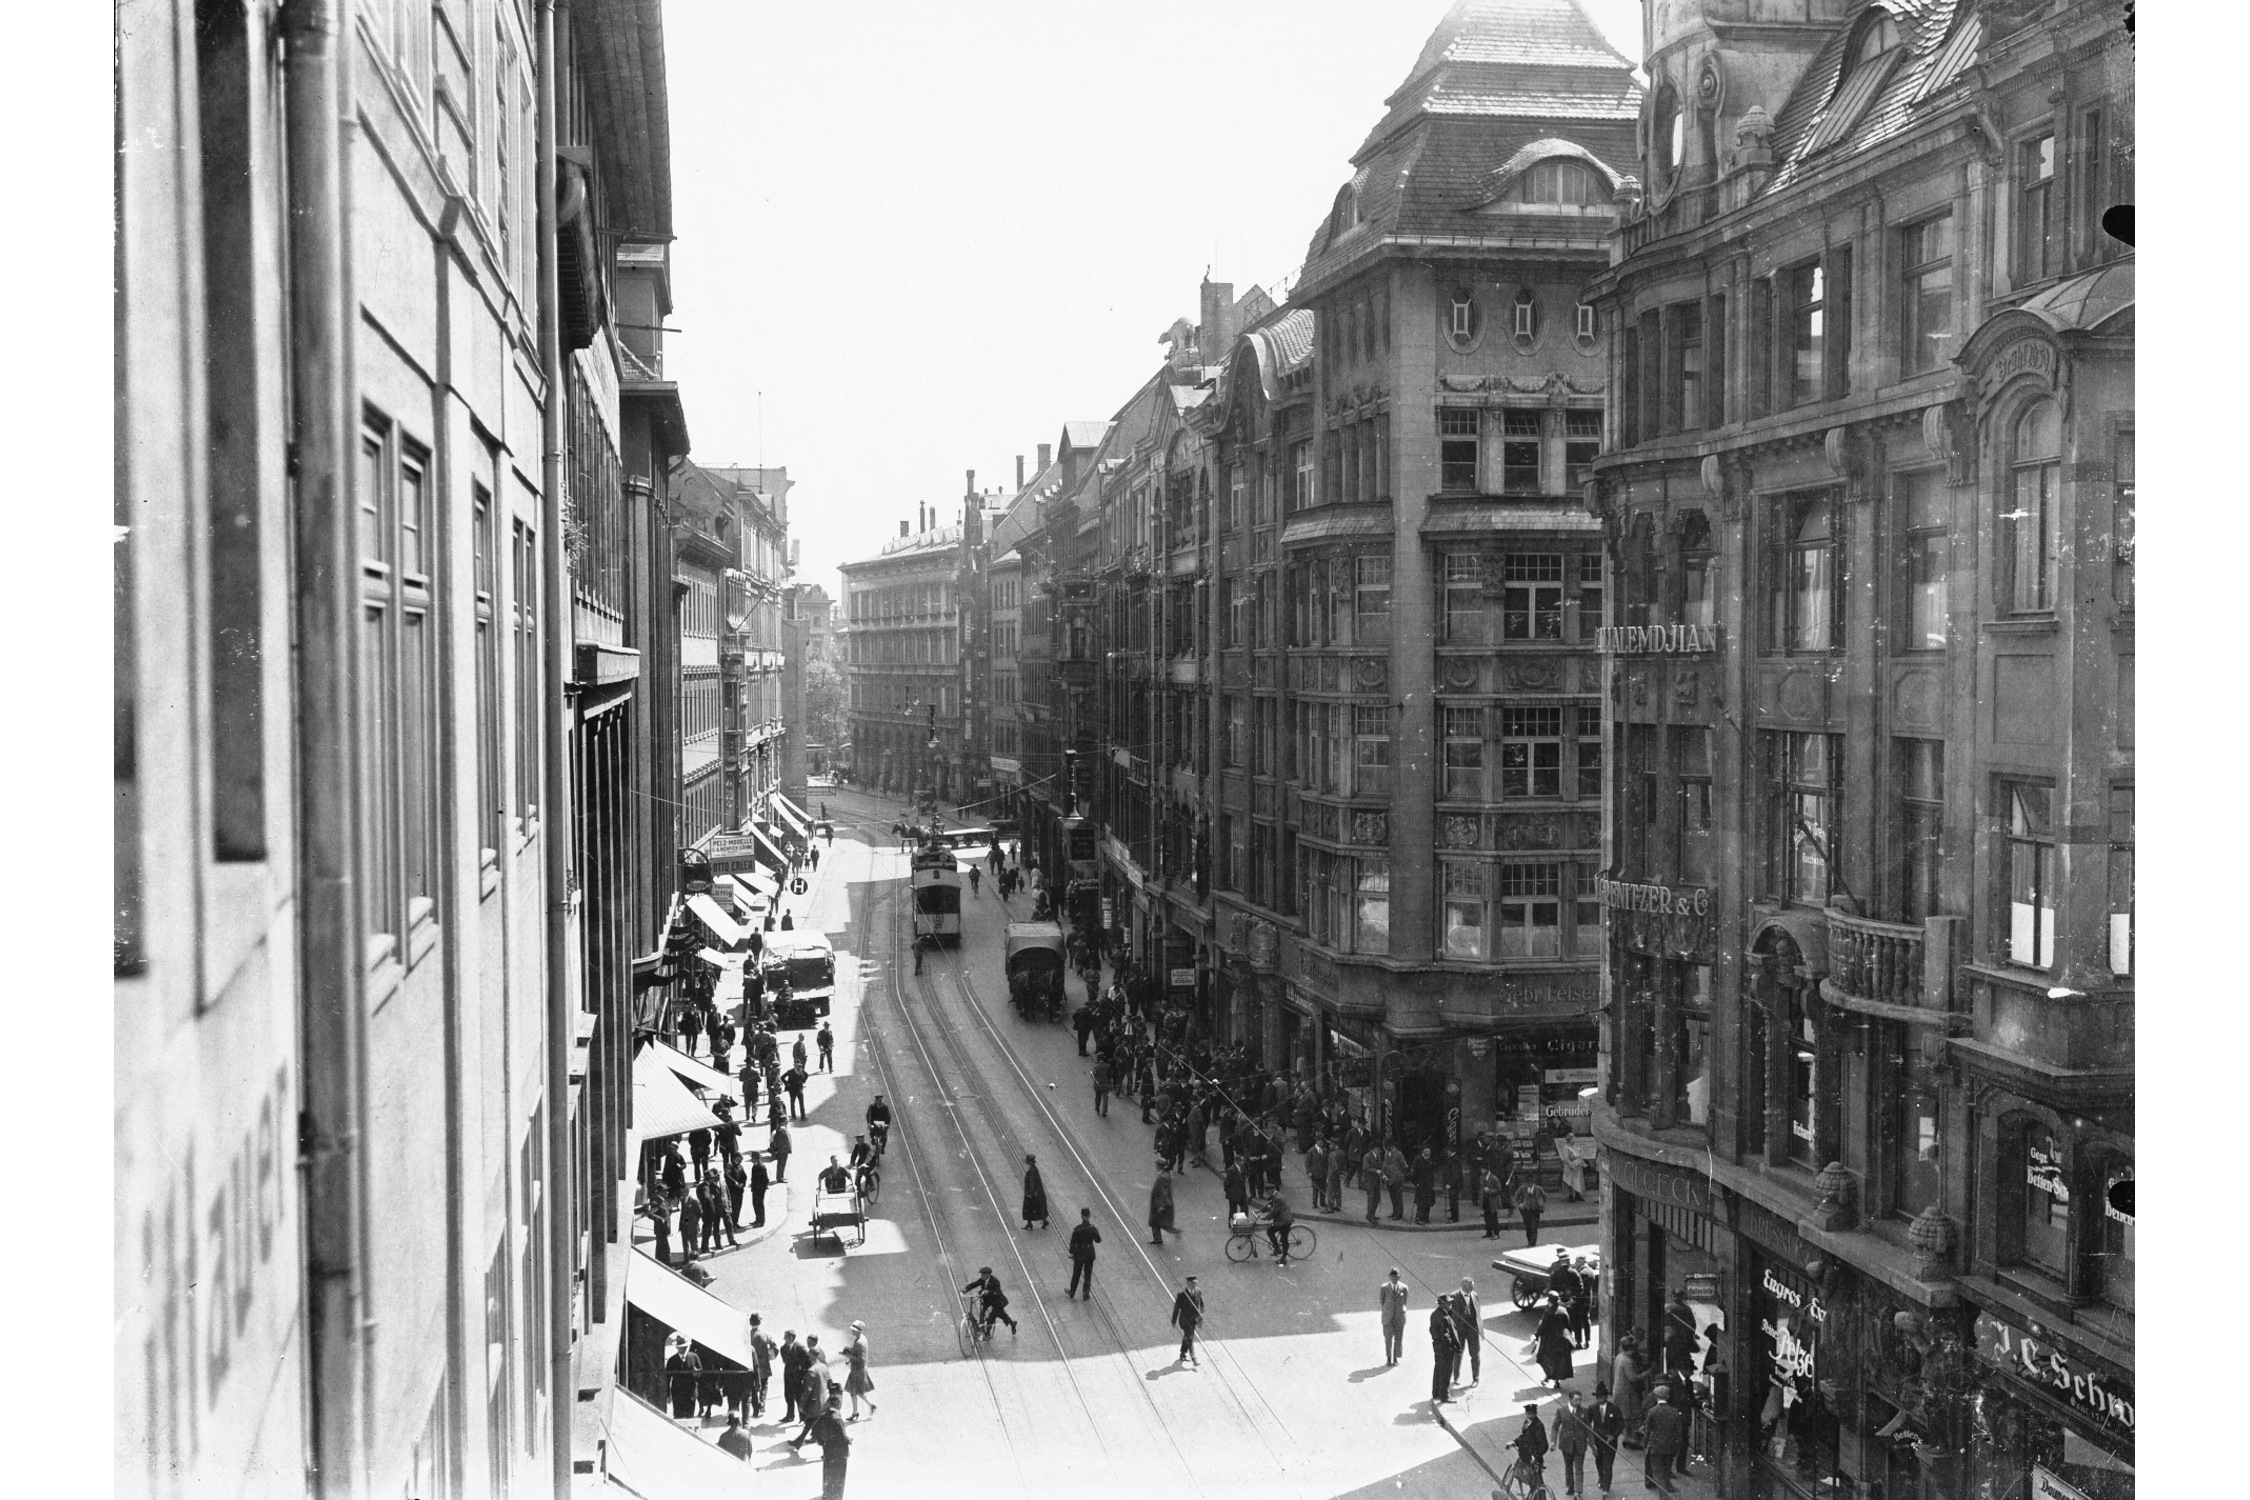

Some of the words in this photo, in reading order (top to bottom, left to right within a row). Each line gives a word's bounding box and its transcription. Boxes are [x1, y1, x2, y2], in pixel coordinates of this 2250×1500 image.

[714, 862, 729, 872] OTTO
[732, 860, 752, 872] ERLER
[1676, 897, 1690, 915] &
[1546, 1105, 1590, 1117] Gebrüder
[1763, 1269, 1801, 1308] Engros
